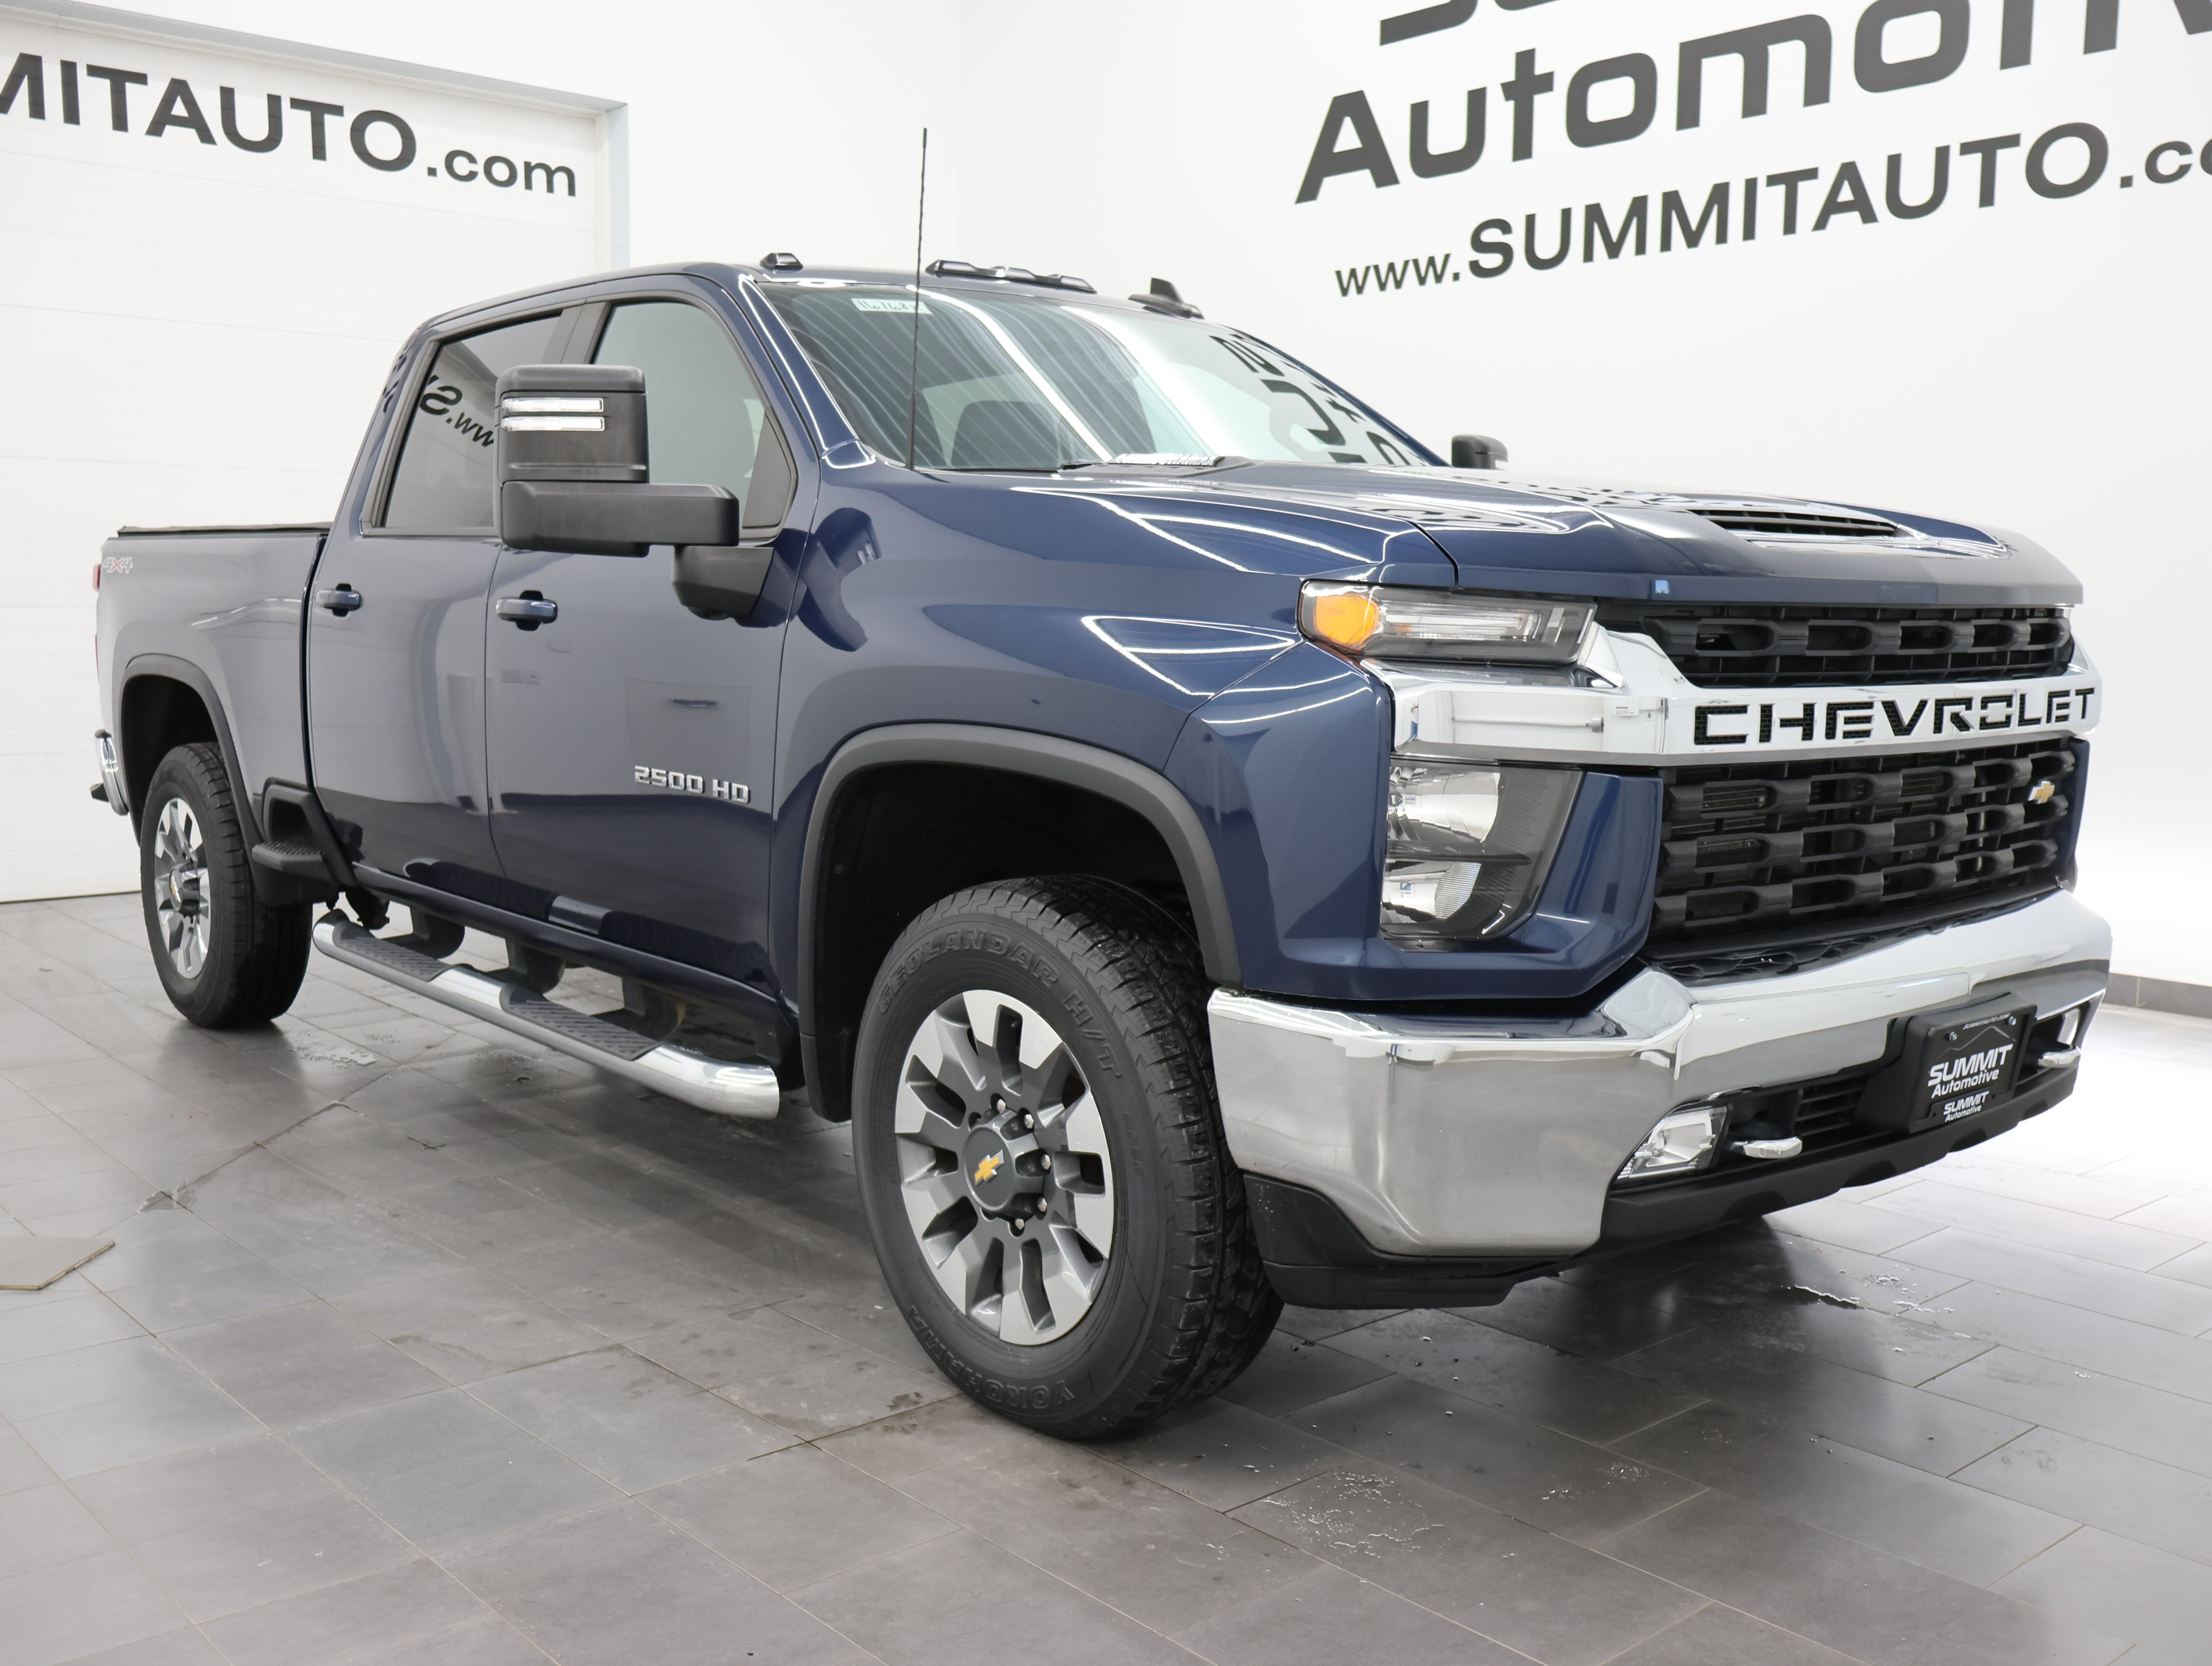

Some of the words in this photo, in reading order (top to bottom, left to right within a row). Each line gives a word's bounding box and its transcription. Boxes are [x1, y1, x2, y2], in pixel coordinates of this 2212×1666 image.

[1335, 122, 2212, 297] www.SUMMITAUTO.c
[1694, 688, 2094, 745] CHEVROLET
[635, 766, 704, 794] 2500
[713, 779, 750, 803] HD
[879, 929, 1060, 1013] GEOLANDAR
[1063, 990, 1122, 1078] H/T
[1928, 1044, 2014, 1087] SUMMIT
[1931, 1069, 1999, 1099] Automotive
[1943, 1091, 1989, 1115] SUMMIT
[1945, 1105, 1982, 1122] Automotive
[909, 1305, 1075, 1409] YOKOHAMA
